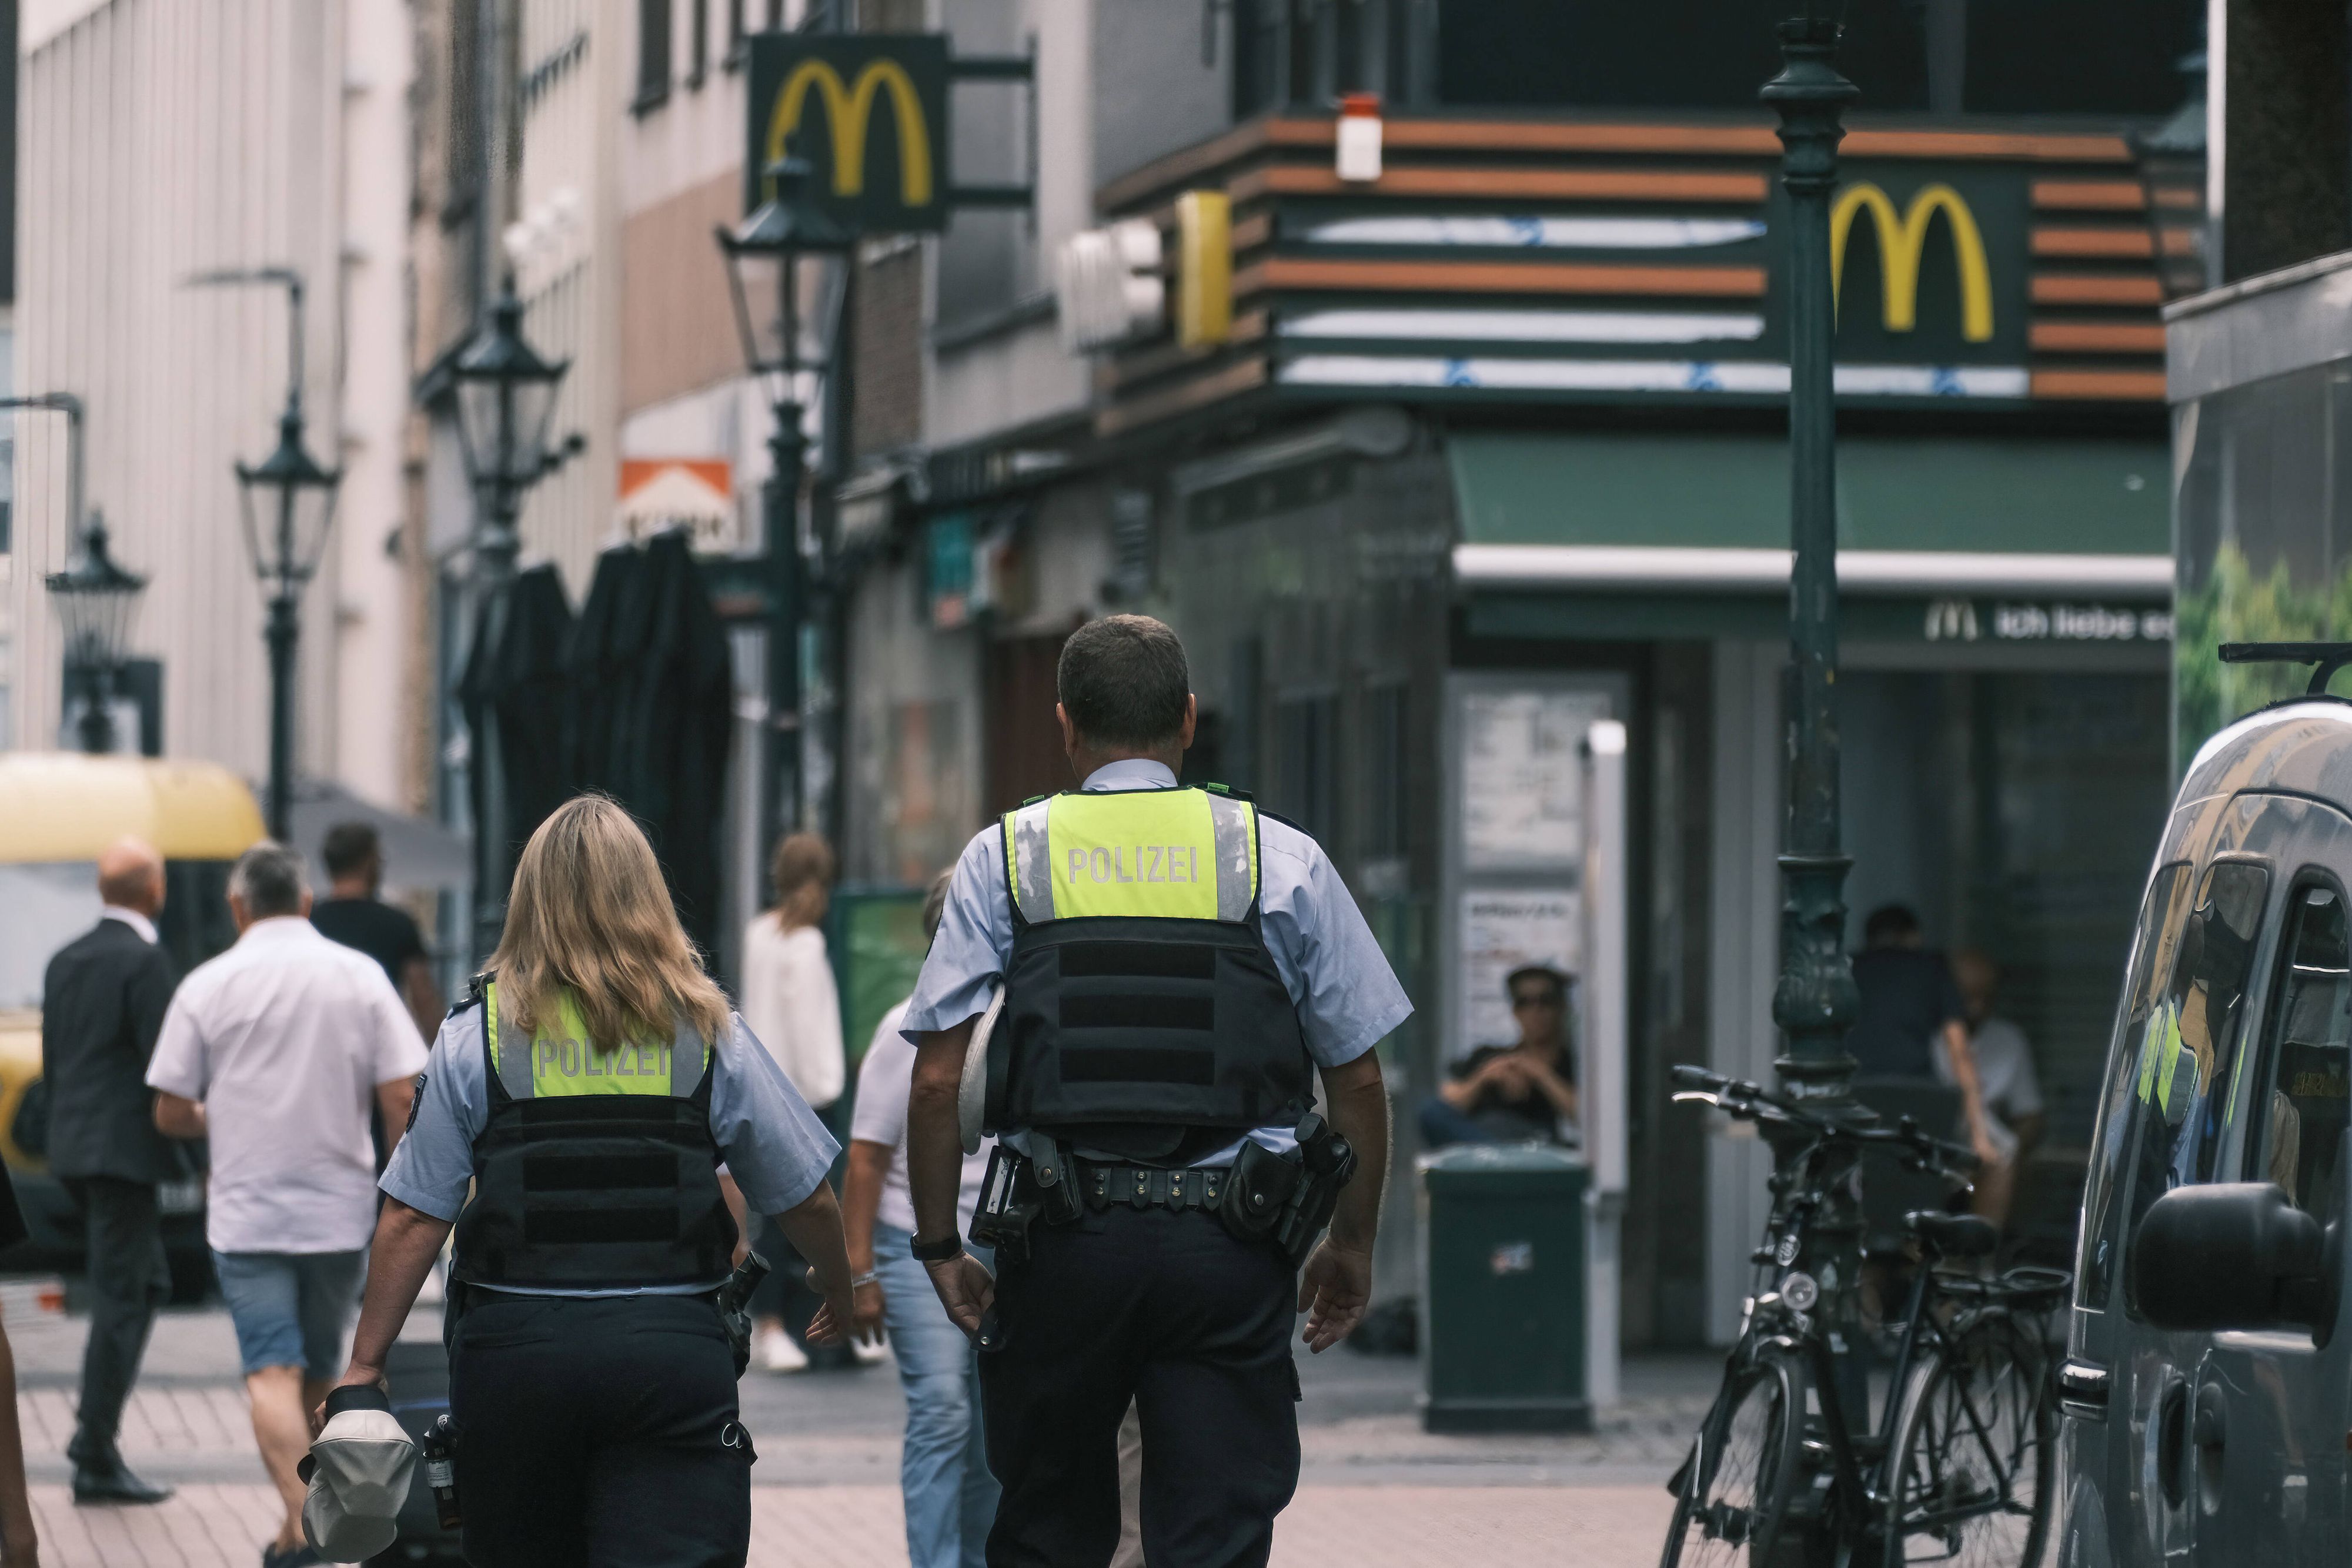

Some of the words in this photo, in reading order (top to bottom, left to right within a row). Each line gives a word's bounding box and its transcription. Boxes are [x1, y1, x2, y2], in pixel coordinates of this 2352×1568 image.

[764, 58, 931, 205] M
[1829, 180, 1994, 342] M
[2052, 604, 2137, 640] liebe
[1068, 846, 1197, 884] POLIZEI
[539, 1037, 667, 1078] POLIZEI
